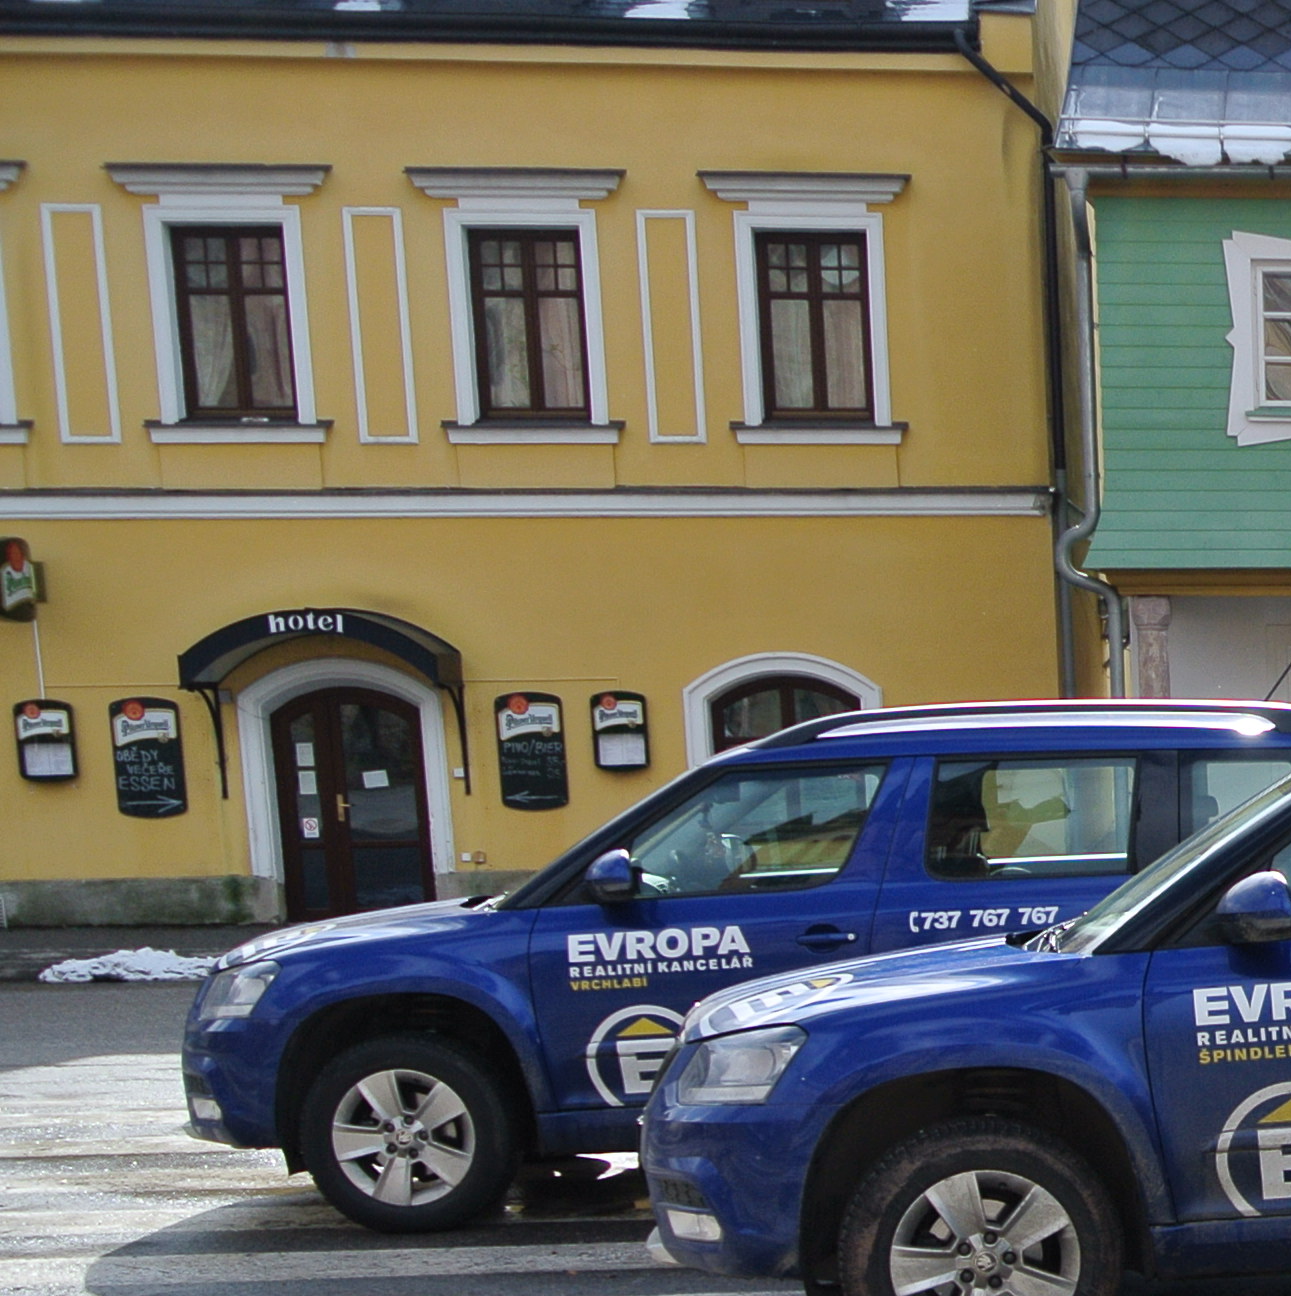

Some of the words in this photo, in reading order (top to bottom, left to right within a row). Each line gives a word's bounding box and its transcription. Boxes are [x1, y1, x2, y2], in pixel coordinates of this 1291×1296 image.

[268, 612, 344, 634] hotel
[118, 776, 175, 791] ESSEN
[921, 911, 962, 930] 737
[969, 908, 1010, 927] 767
[1018, 905, 1059, 925] 767
[567, 925, 751, 963] EVROPA
[569, 960, 652, 978] REALITNÍ
[658, 955, 753, 973] KANCELÁŘ
[569, 977, 648, 991] VRCHLABÍ
